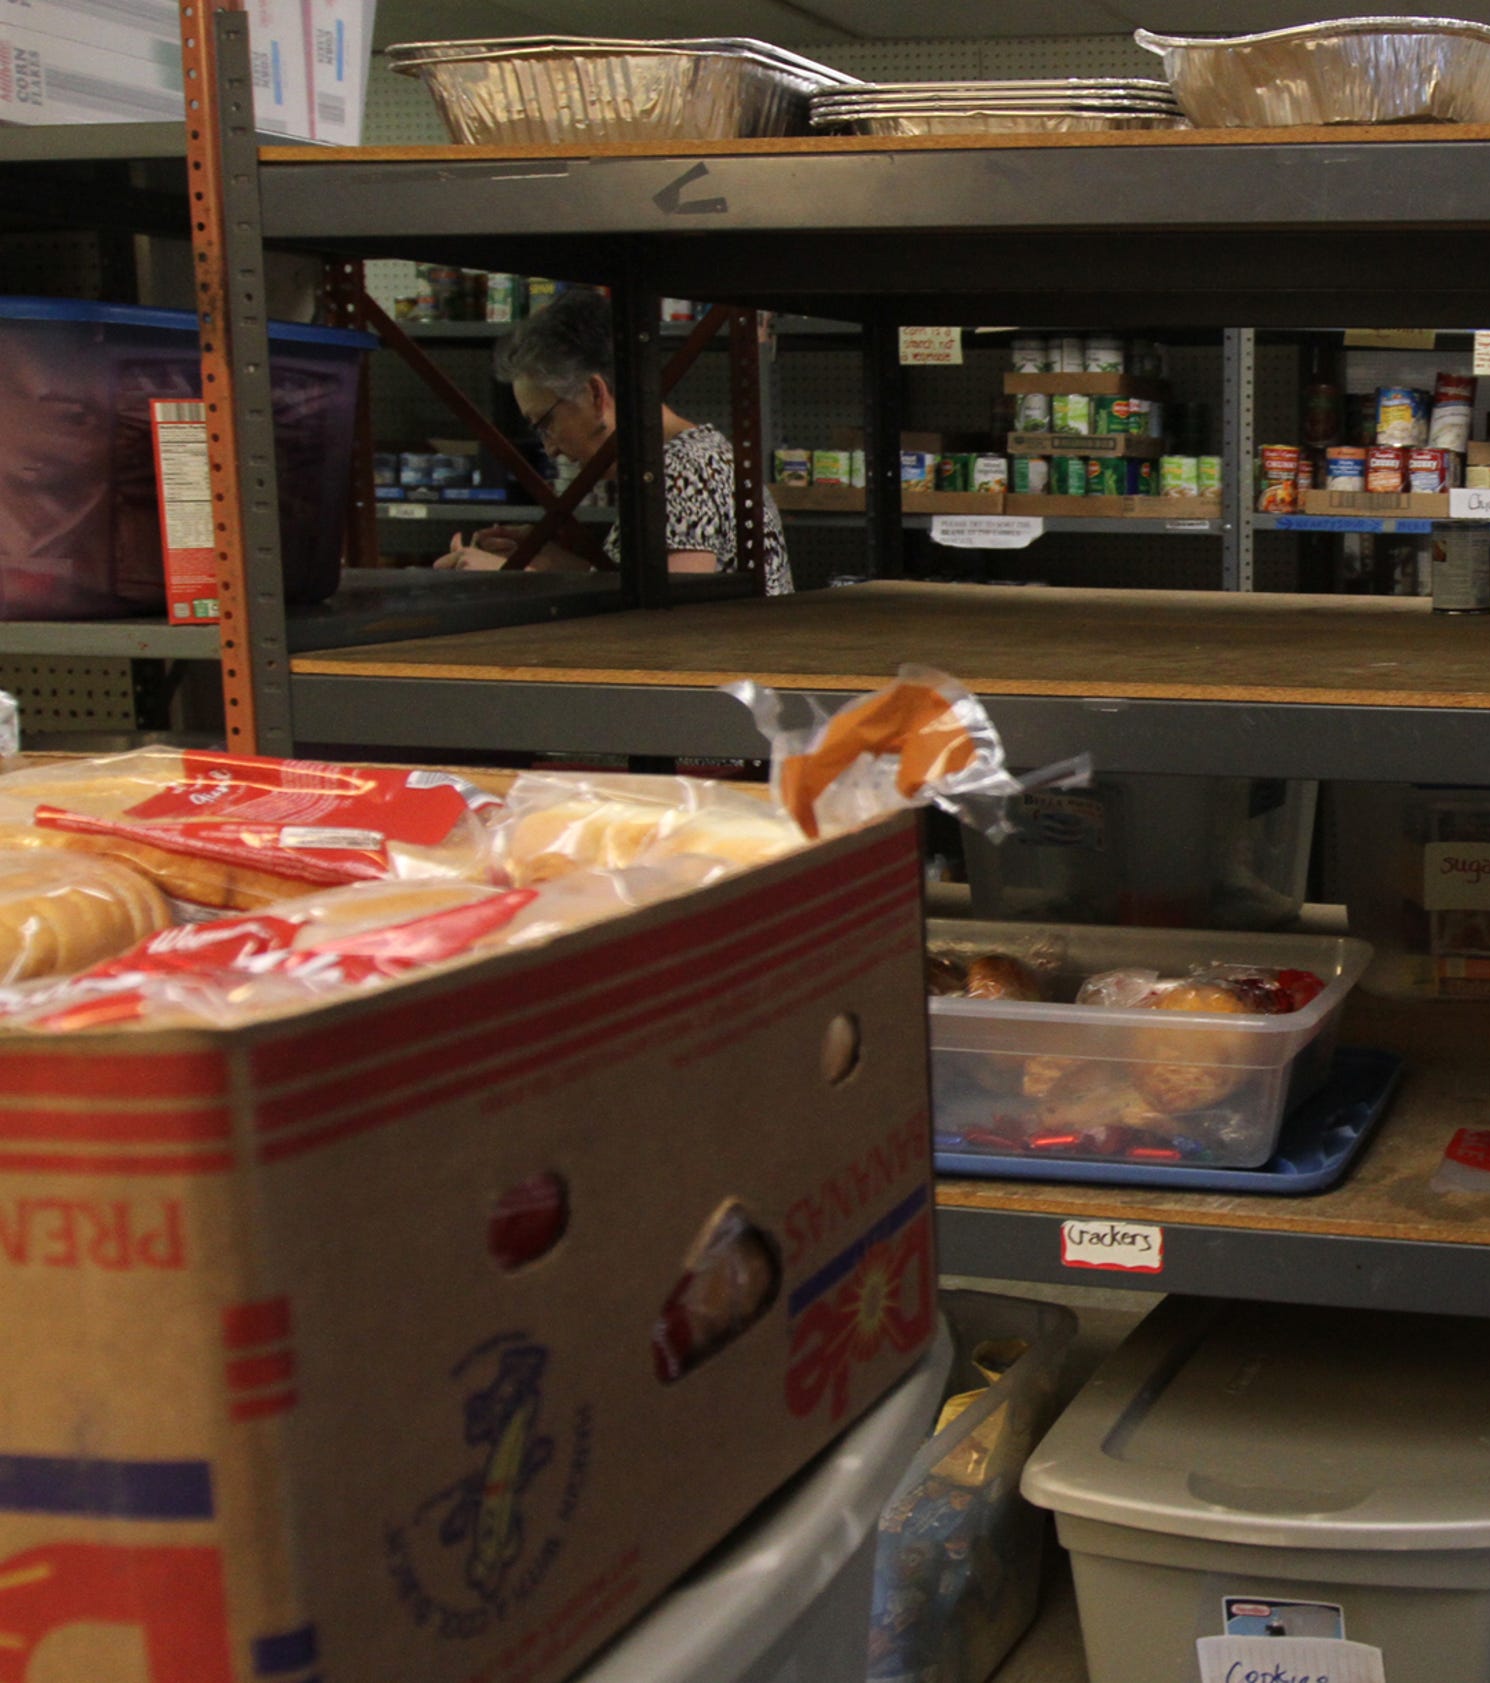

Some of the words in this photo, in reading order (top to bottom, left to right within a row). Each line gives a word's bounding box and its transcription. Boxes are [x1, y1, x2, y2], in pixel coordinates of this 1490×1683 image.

[14, 47, 29, 103] CORN
[28, 50, 43, 107] FLAKES
[1067, 1224, 1152, 1252] Crackers
